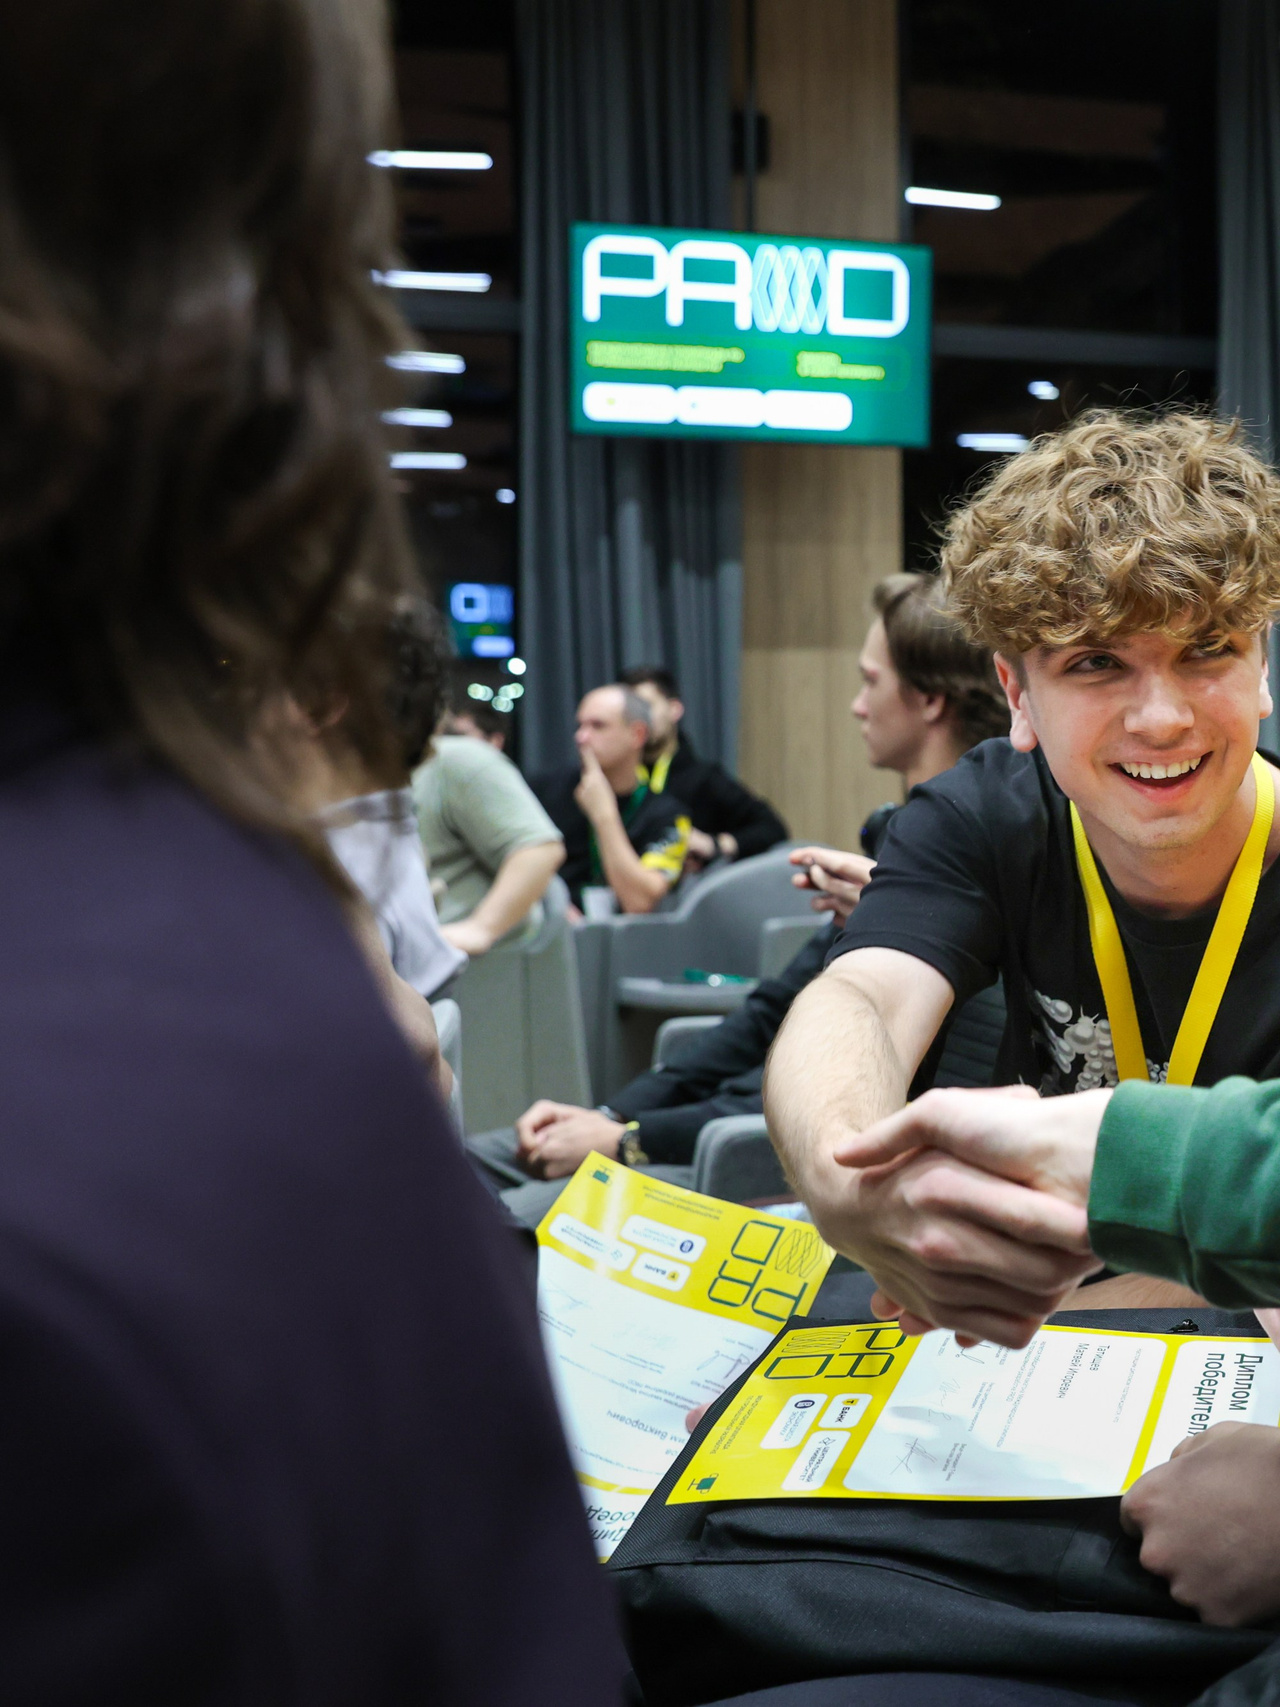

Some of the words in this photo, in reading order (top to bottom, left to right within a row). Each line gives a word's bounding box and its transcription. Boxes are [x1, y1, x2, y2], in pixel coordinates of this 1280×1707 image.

[1068, 1342, 1090, 1367] Матвей
[1088, 1344, 1110, 1371] Татищев
[1055, 1367, 1079, 1398] Игоревич
[1227, 1352, 1263, 1411] Диплом
[604, 1408, 668, 1441] Викторович
[833, 1406, 851, 1423] БАНК
